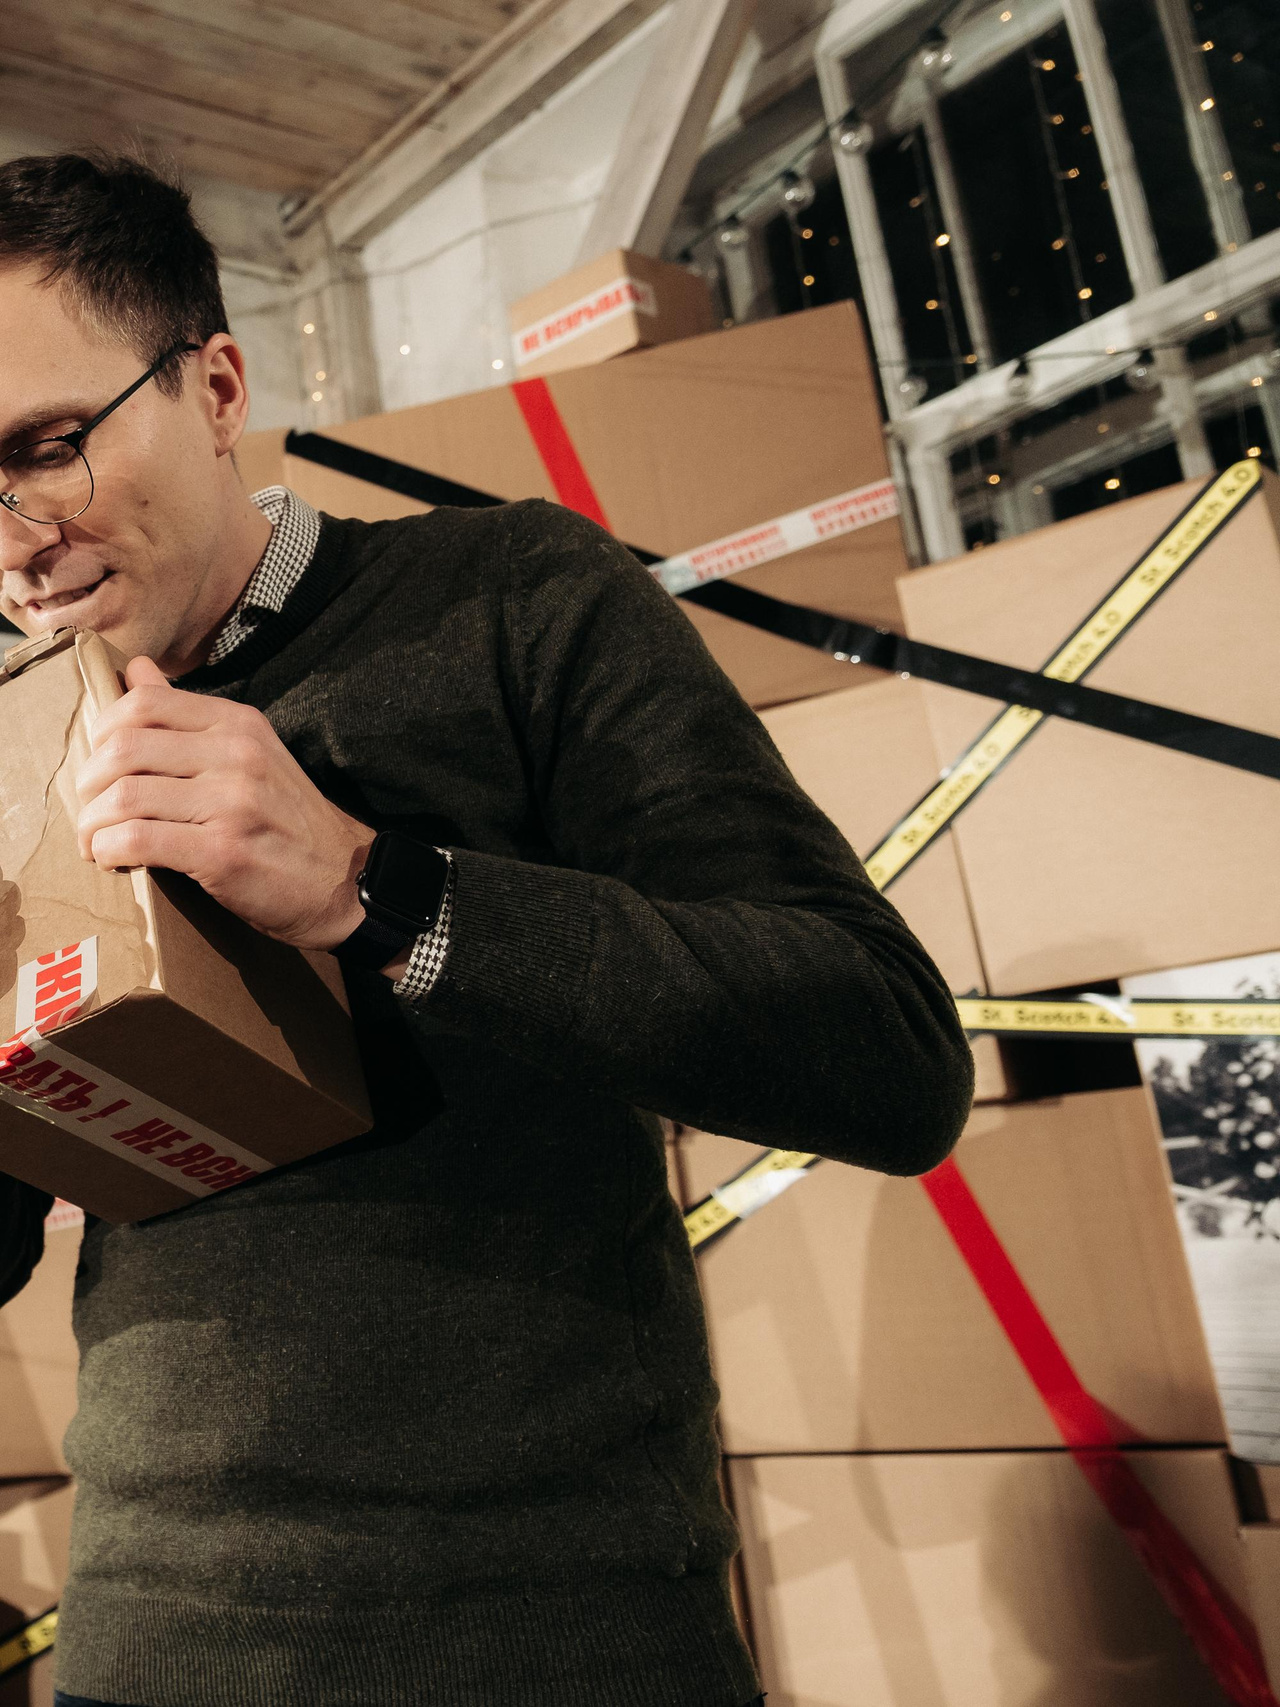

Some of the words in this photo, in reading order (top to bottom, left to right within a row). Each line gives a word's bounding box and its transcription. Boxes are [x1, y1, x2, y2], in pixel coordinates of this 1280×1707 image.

[1163, 501, 1224, 559] Scotch
[1015, 1008, 1090, 1025] Scotch
[110, 1117, 193, 1155] НЕ
